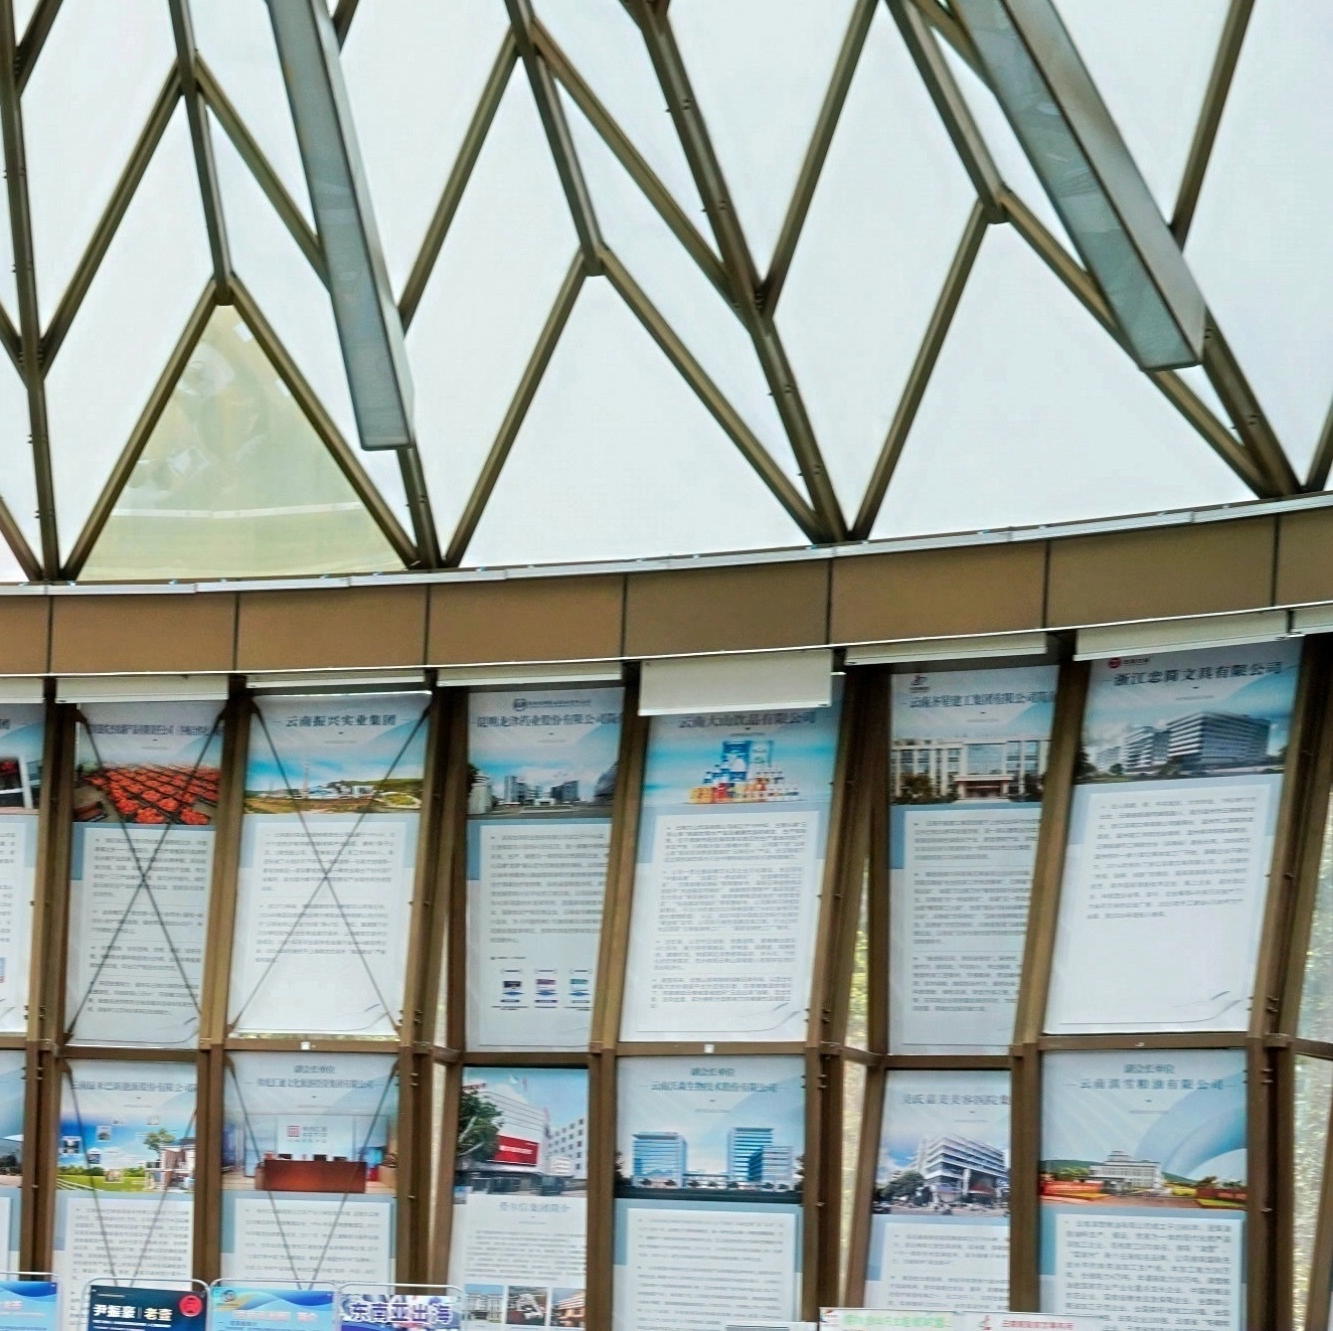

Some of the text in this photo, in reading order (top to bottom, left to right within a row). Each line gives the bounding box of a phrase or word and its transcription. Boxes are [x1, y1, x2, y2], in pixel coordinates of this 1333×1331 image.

[349, 1301, 454, 1325] 东南亚出海
